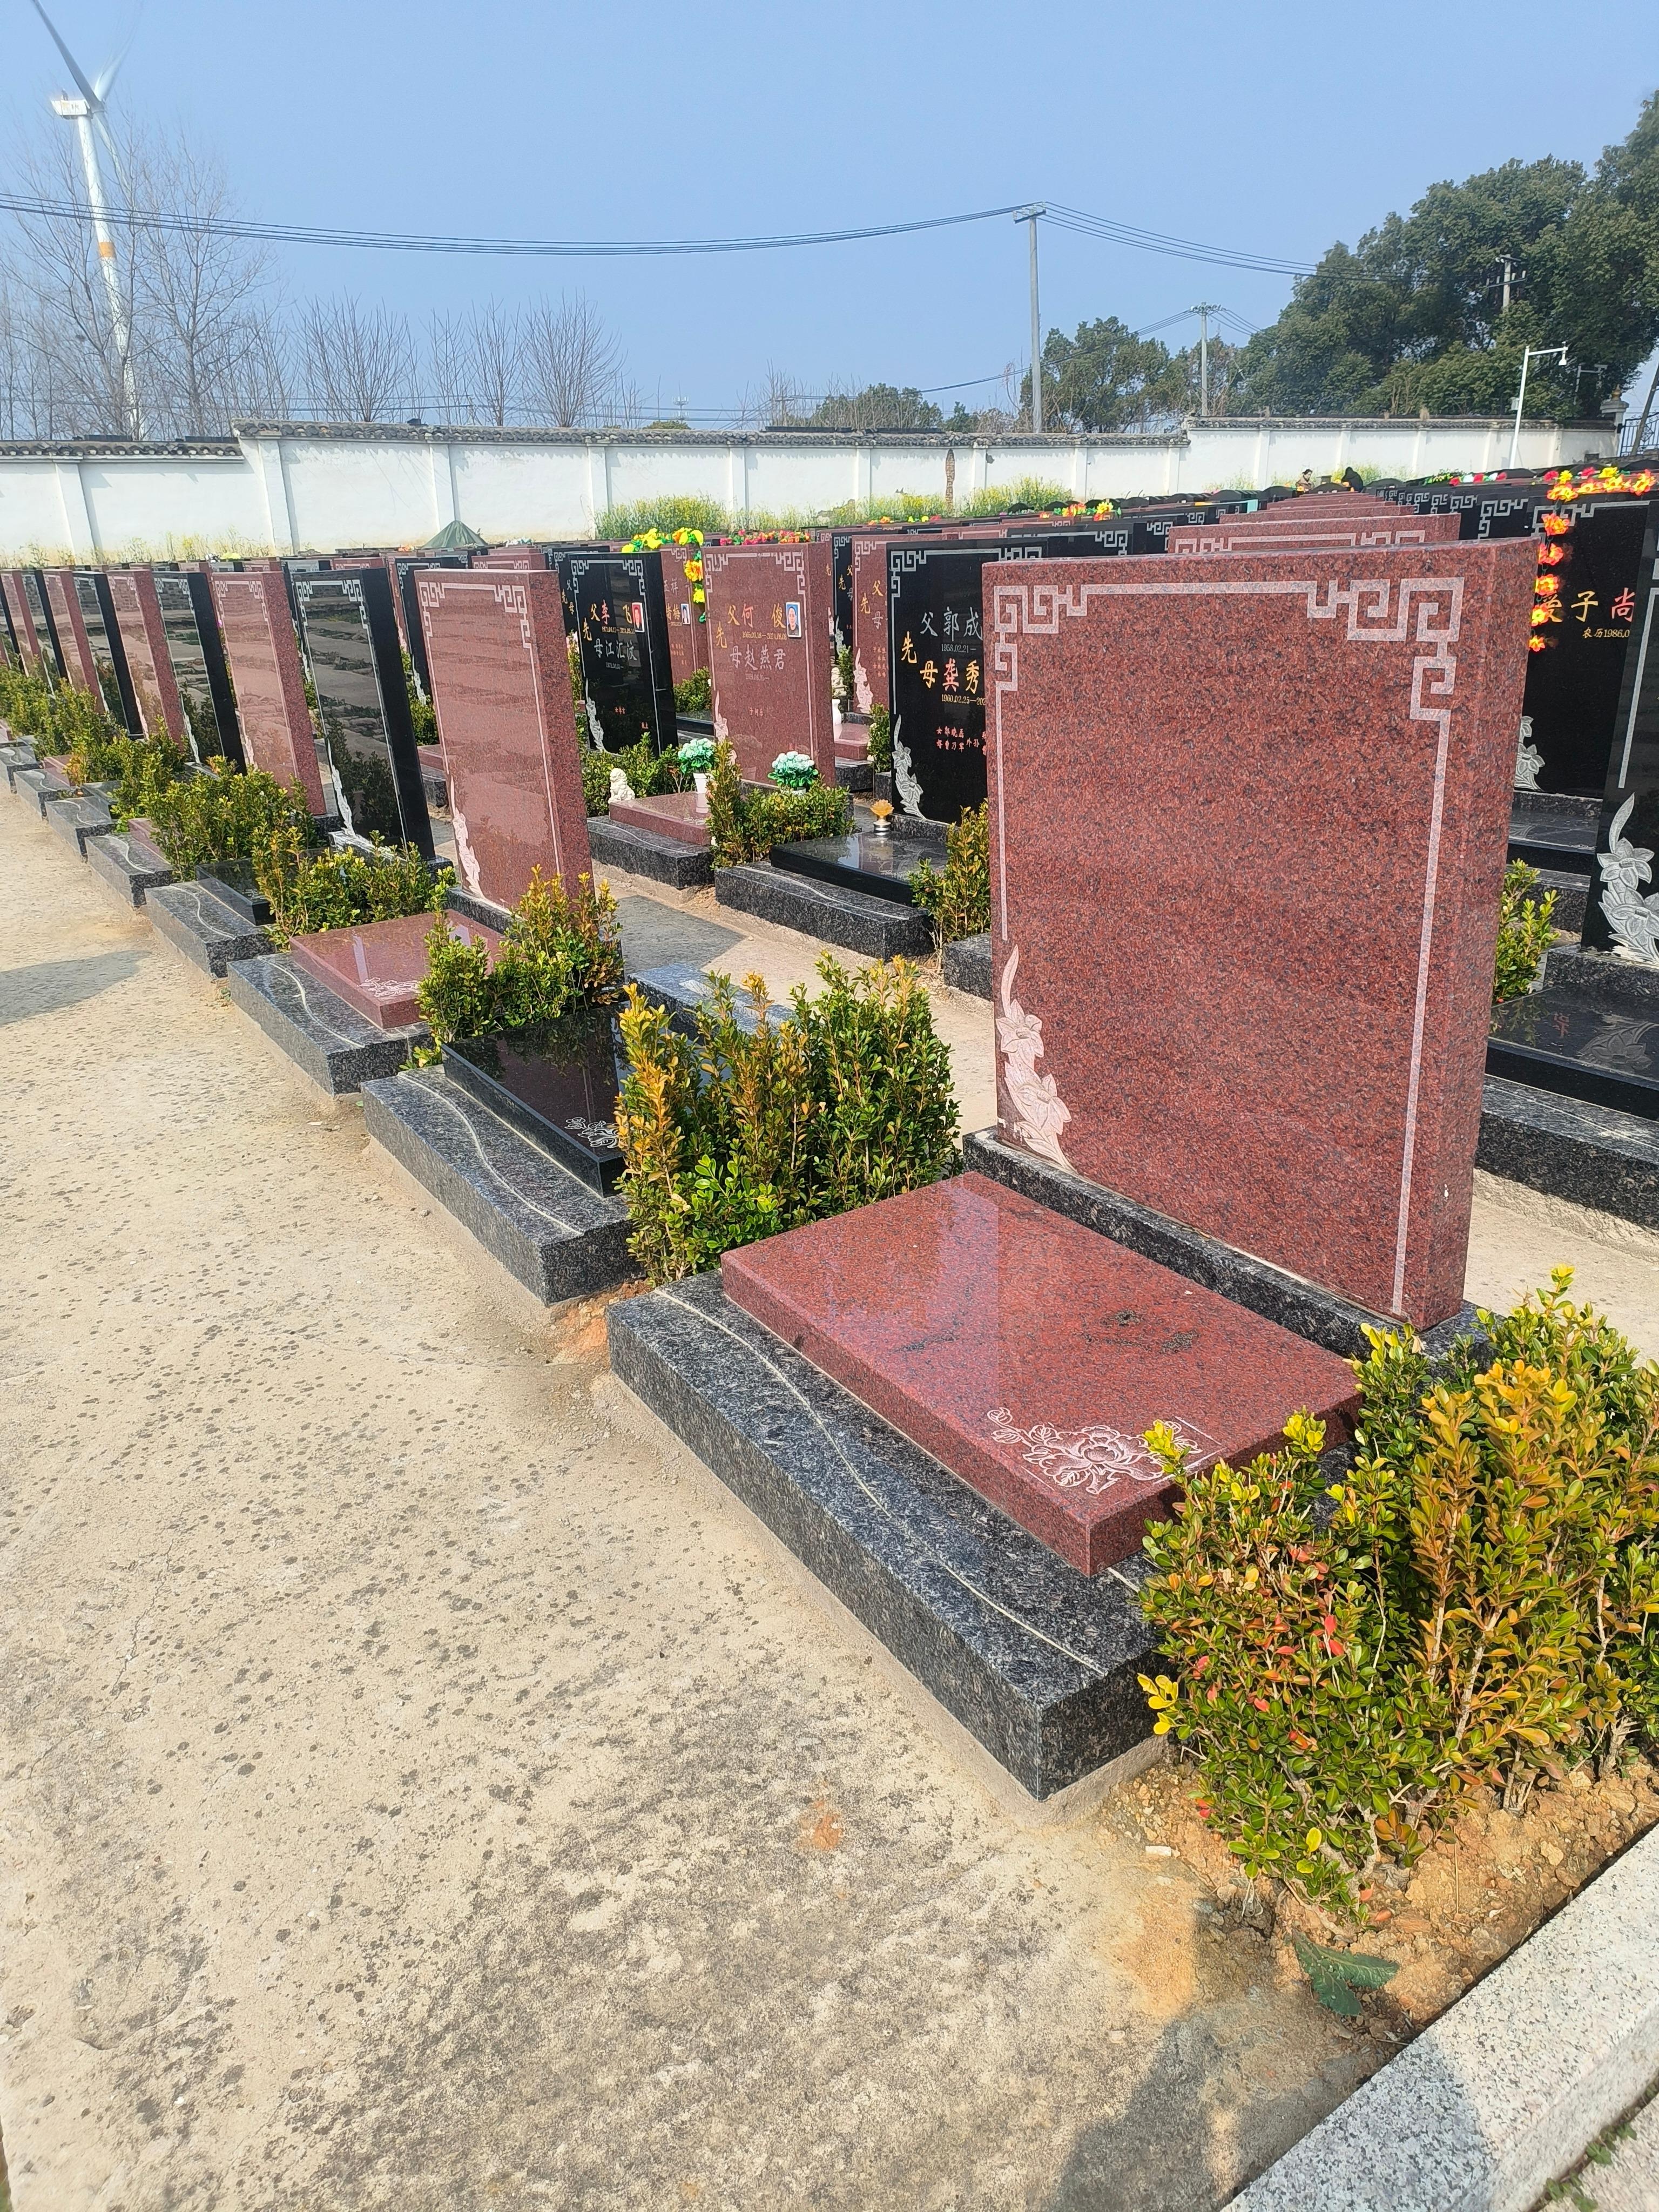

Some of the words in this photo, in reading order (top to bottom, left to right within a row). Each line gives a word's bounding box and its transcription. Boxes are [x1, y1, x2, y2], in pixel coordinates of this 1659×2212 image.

[838, 574, 846, 590] 先
[872, 579, 884, 596] 父
[860, 592, 871, 614] 先
[583, 617, 592, 641] 先
[872, 611, 884, 629] 母
[920, 606, 983, 642] 父郭成
[716, 621, 727, 648] 先
[730, 644, 786, 671] 母赵燕君
[901, 631, 918, 664] 先
[920, 657, 980, 694] 母龚秀
